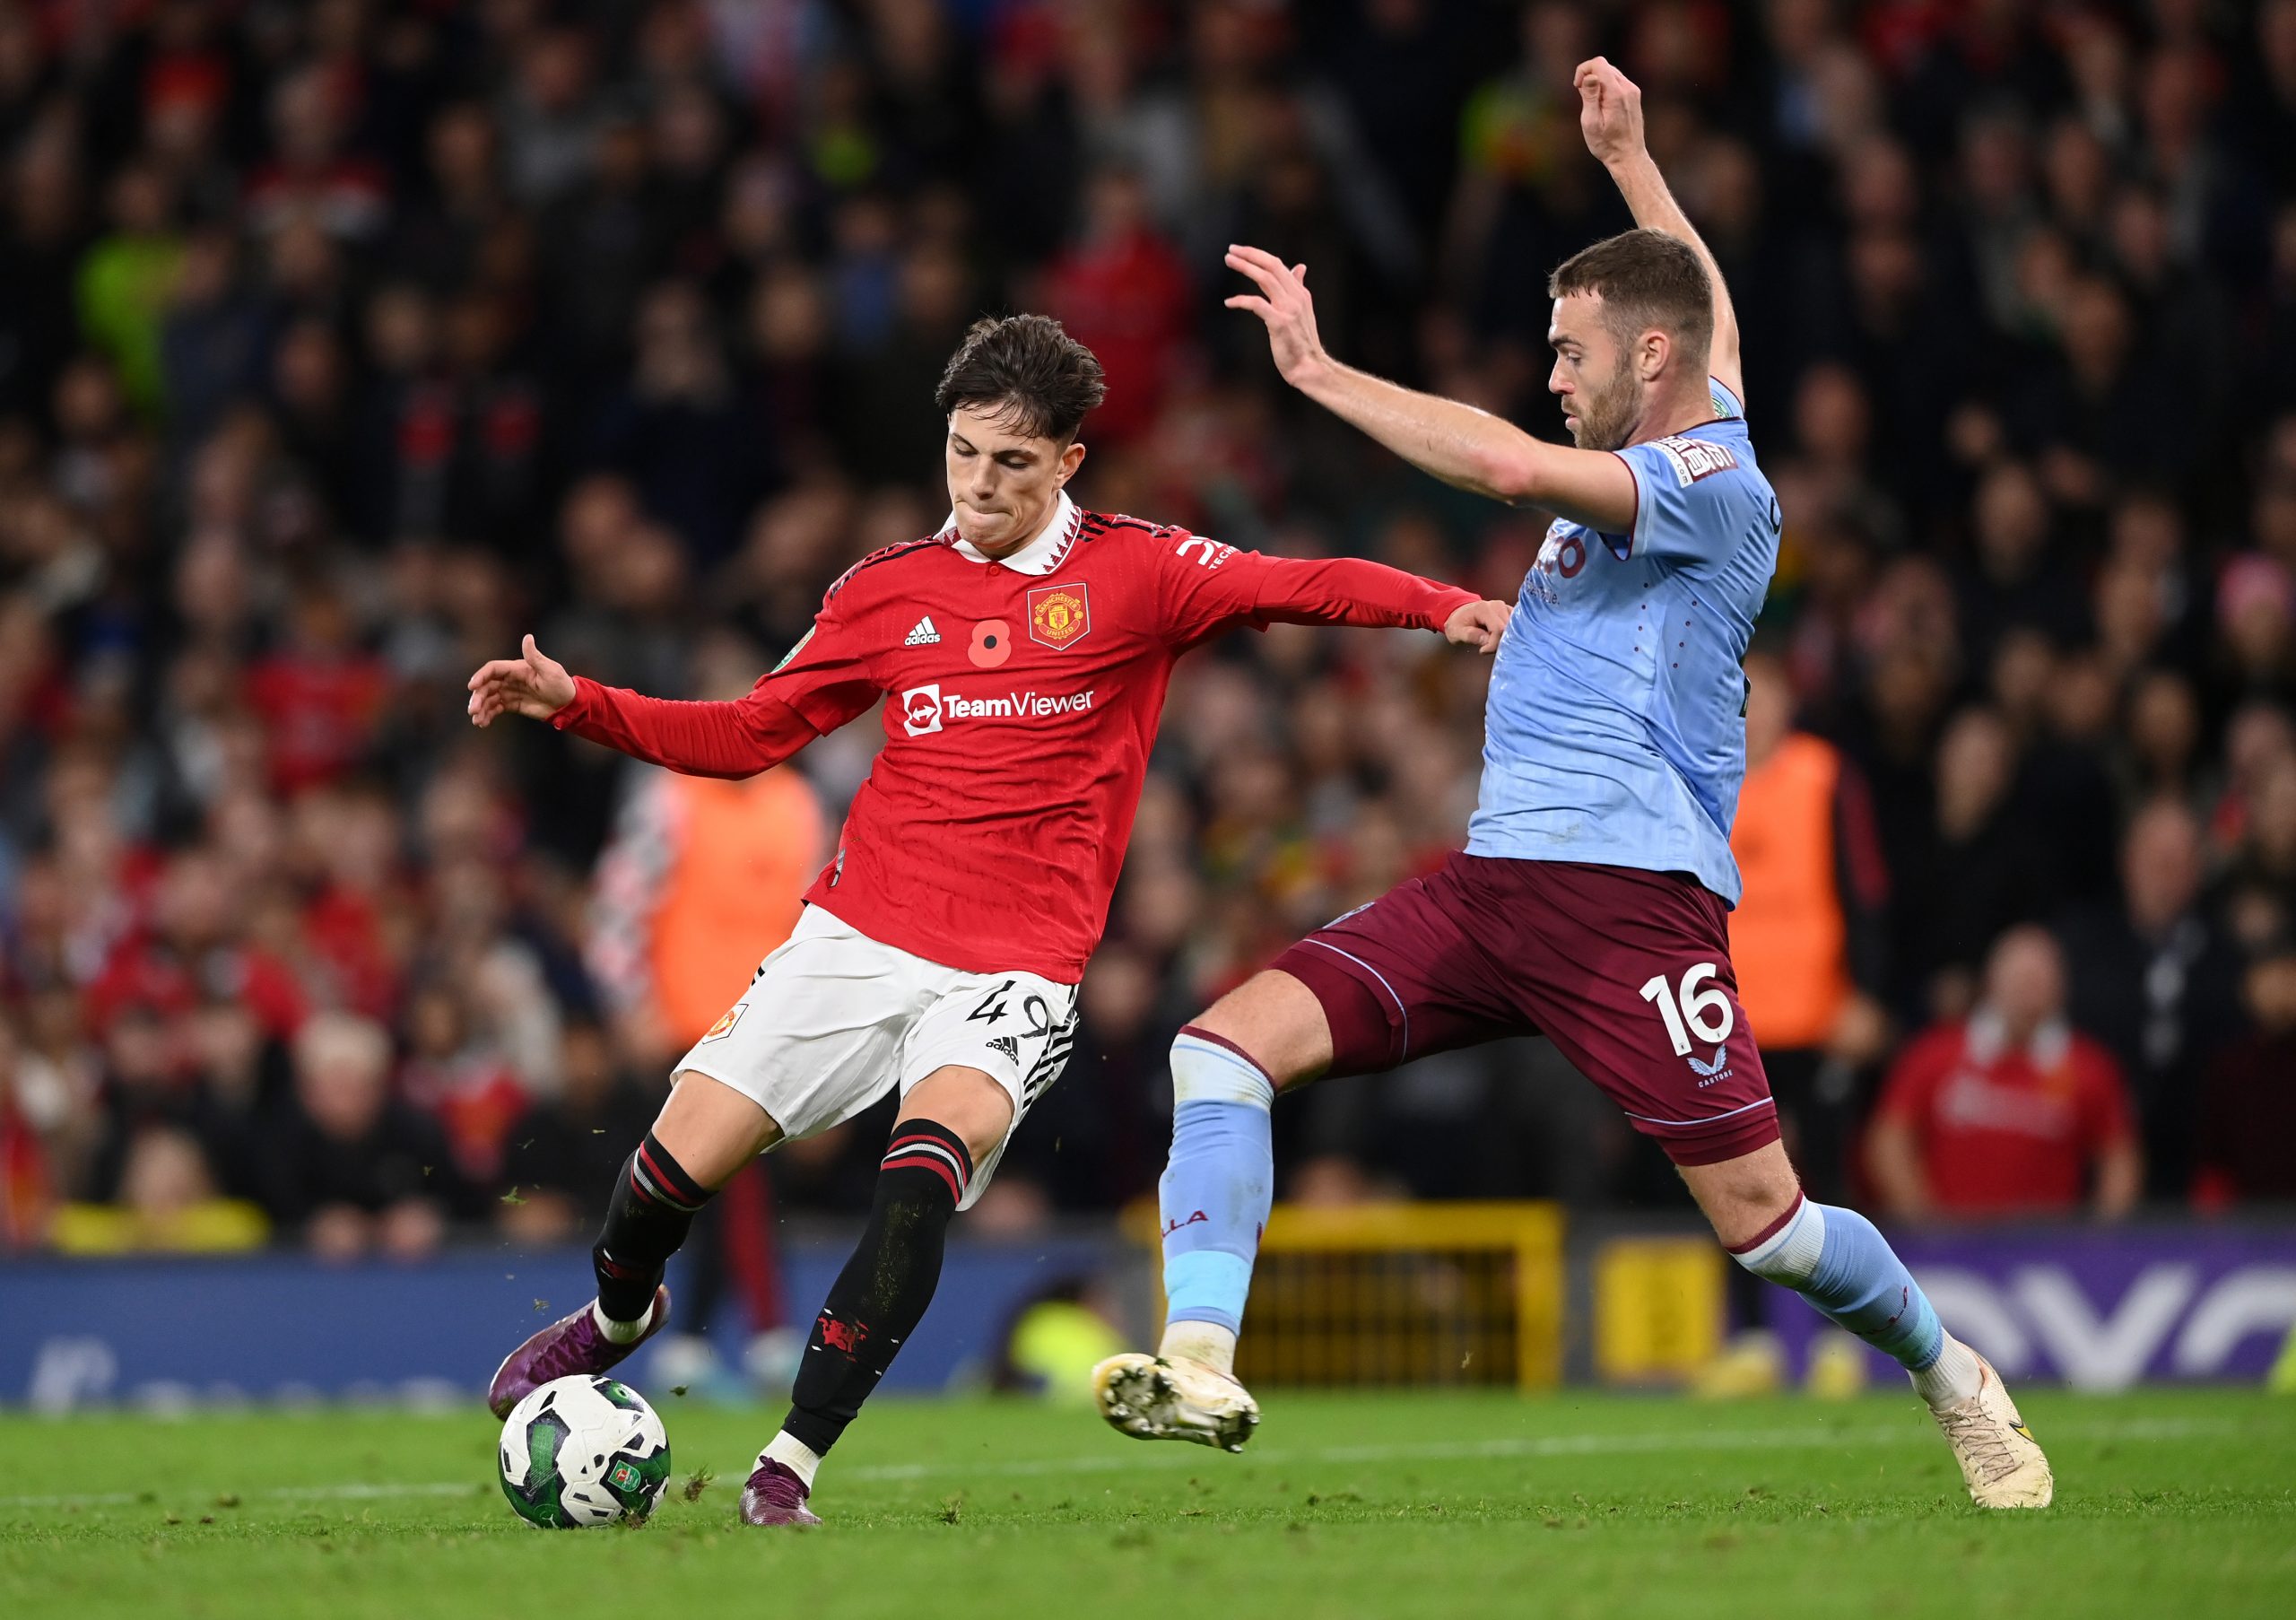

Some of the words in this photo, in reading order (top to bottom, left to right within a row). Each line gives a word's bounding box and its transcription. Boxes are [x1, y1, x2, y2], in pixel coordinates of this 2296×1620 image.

[1038, 595, 1078, 614] MANCHESTER
[904, 633, 941, 646] adidas
[1045, 625, 1074, 637] UNITED
[943, 690, 1094, 719] TeamViewer
[964, 979, 1049, 1040] 49
[1638, 962, 1734, 1057] 16
[1698, 1069, 1734, 1088] CASTORE
